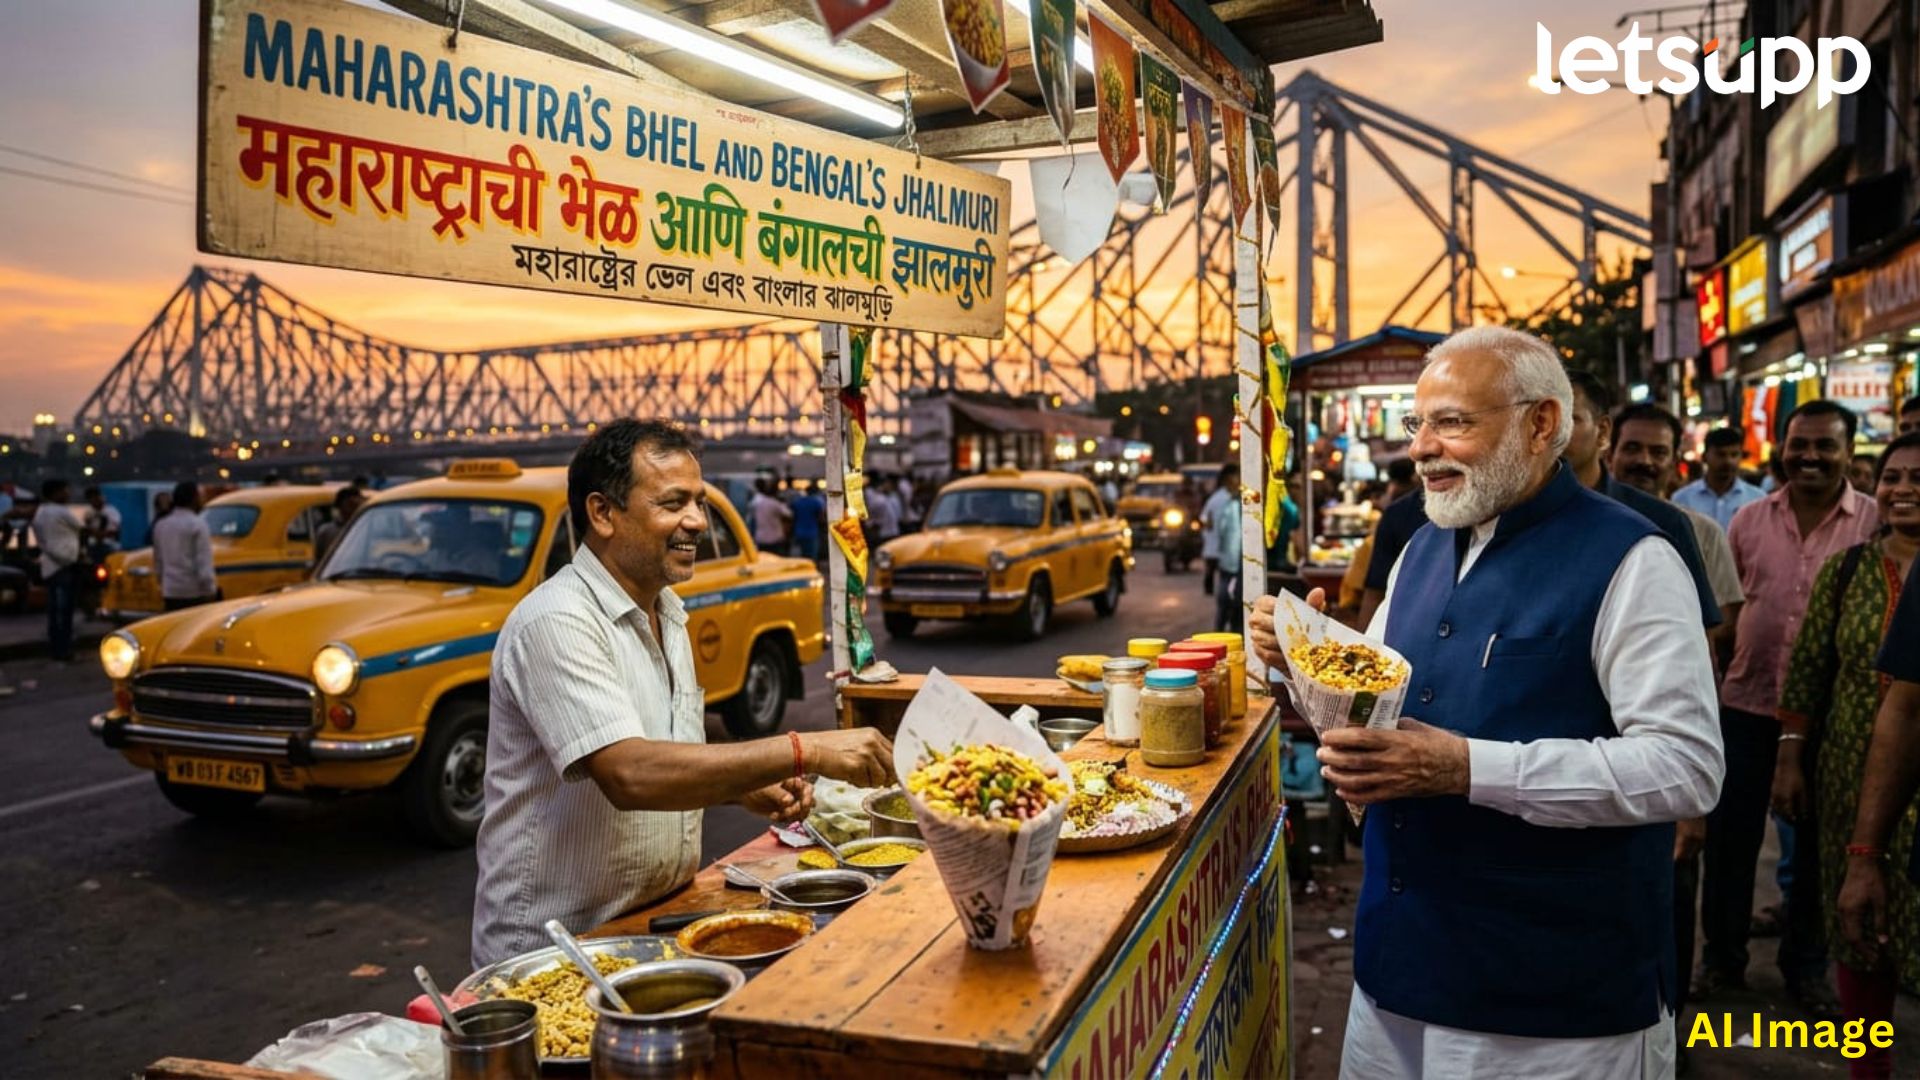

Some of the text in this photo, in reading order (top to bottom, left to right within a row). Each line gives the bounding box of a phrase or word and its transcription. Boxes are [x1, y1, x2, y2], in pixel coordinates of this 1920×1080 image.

[236, 114, 997, 311] महाराष्ट्राची भेळ आणि बंगालची झालमुरी
[243, 12, 998, 235] MAHARASHTRA'S BHEL AND BENGAL'S JHALMURI
[702, 271, 747, 303] এবং
[752, 275, 818, 308] বাংলার
[1071, 804, 1242, 1080] AHARASHTRA'S
